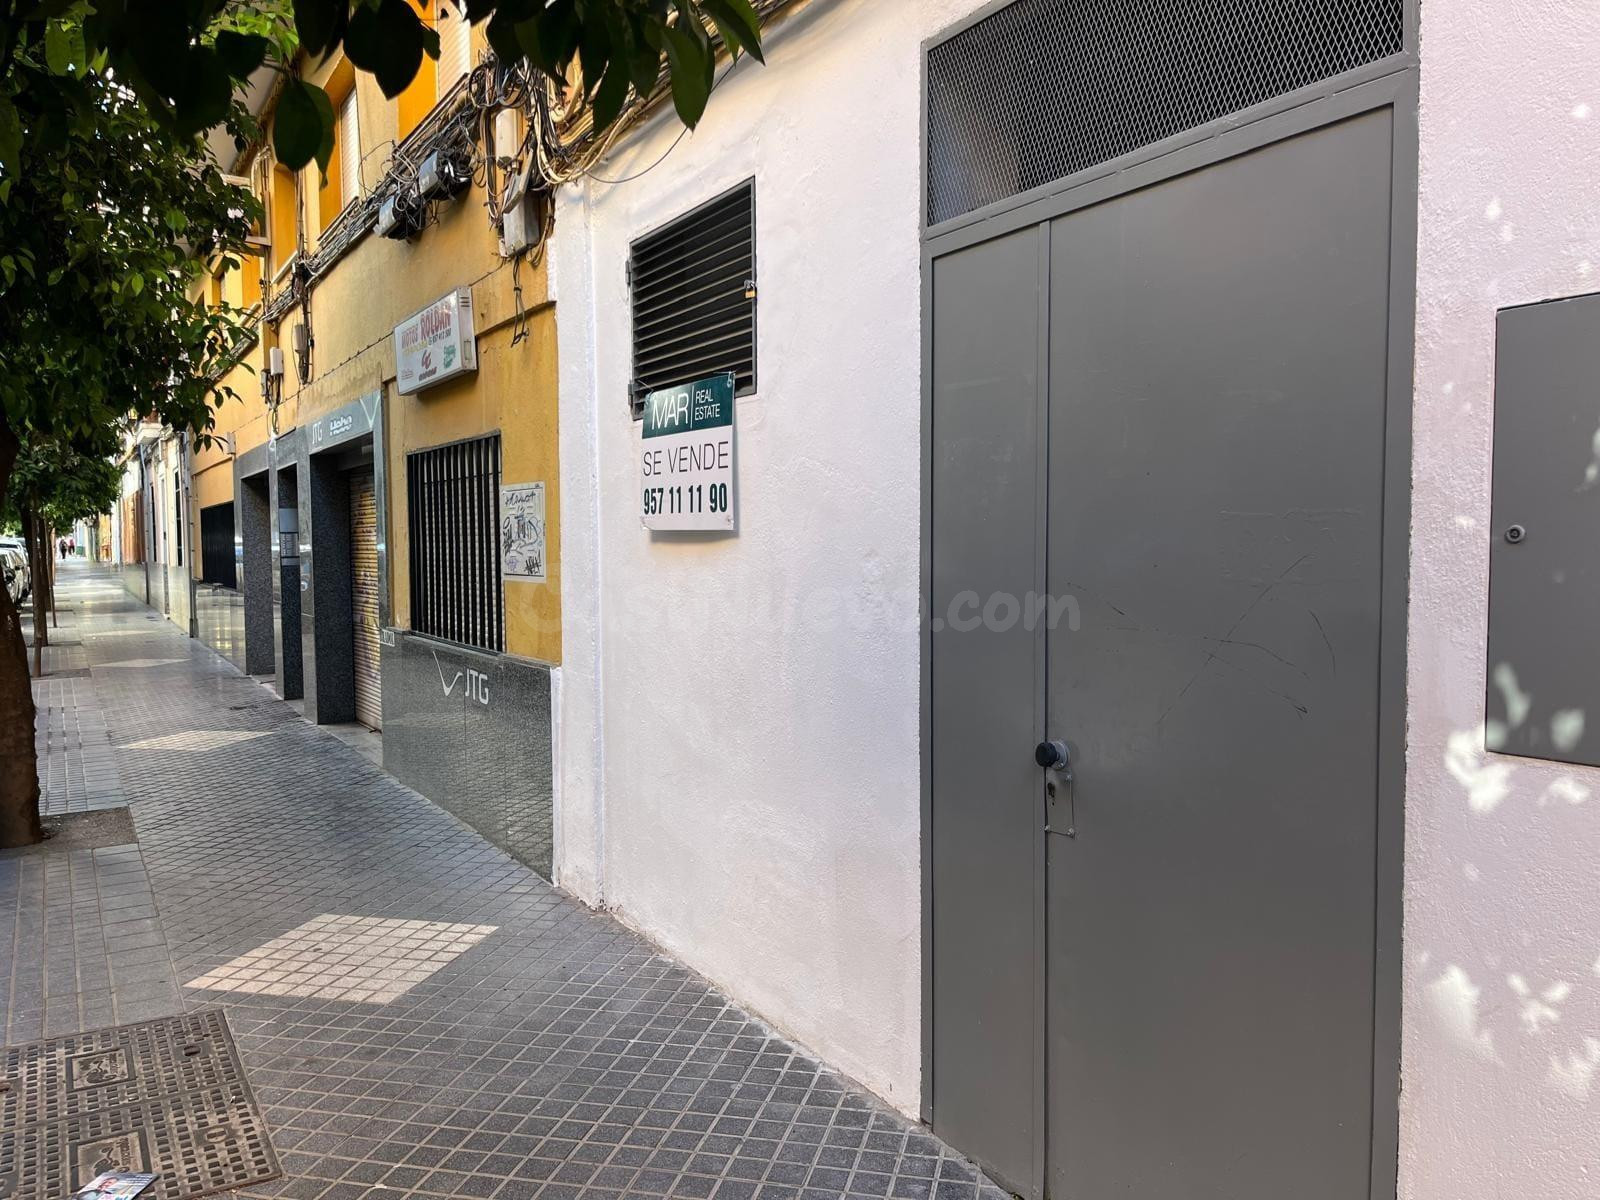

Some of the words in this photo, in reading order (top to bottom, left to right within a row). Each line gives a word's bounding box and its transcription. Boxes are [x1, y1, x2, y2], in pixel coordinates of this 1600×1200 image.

[651, 392, 688, 430] MAR
[694, 403, 721, 421] ESTATE
[695, 388, 714, 404] REAL
[312, 421, 323, 445] JTG
[643, 450, 662, 477] SE
[668, 441, 729, 474] VENDE
[643, 487, 664, 515] 957
[669, 485, 682, 514] 11
[688, 484, 702, 513] 11
[709, 482, 728, 513] 90
[465, 668, 489, 705] JTG
